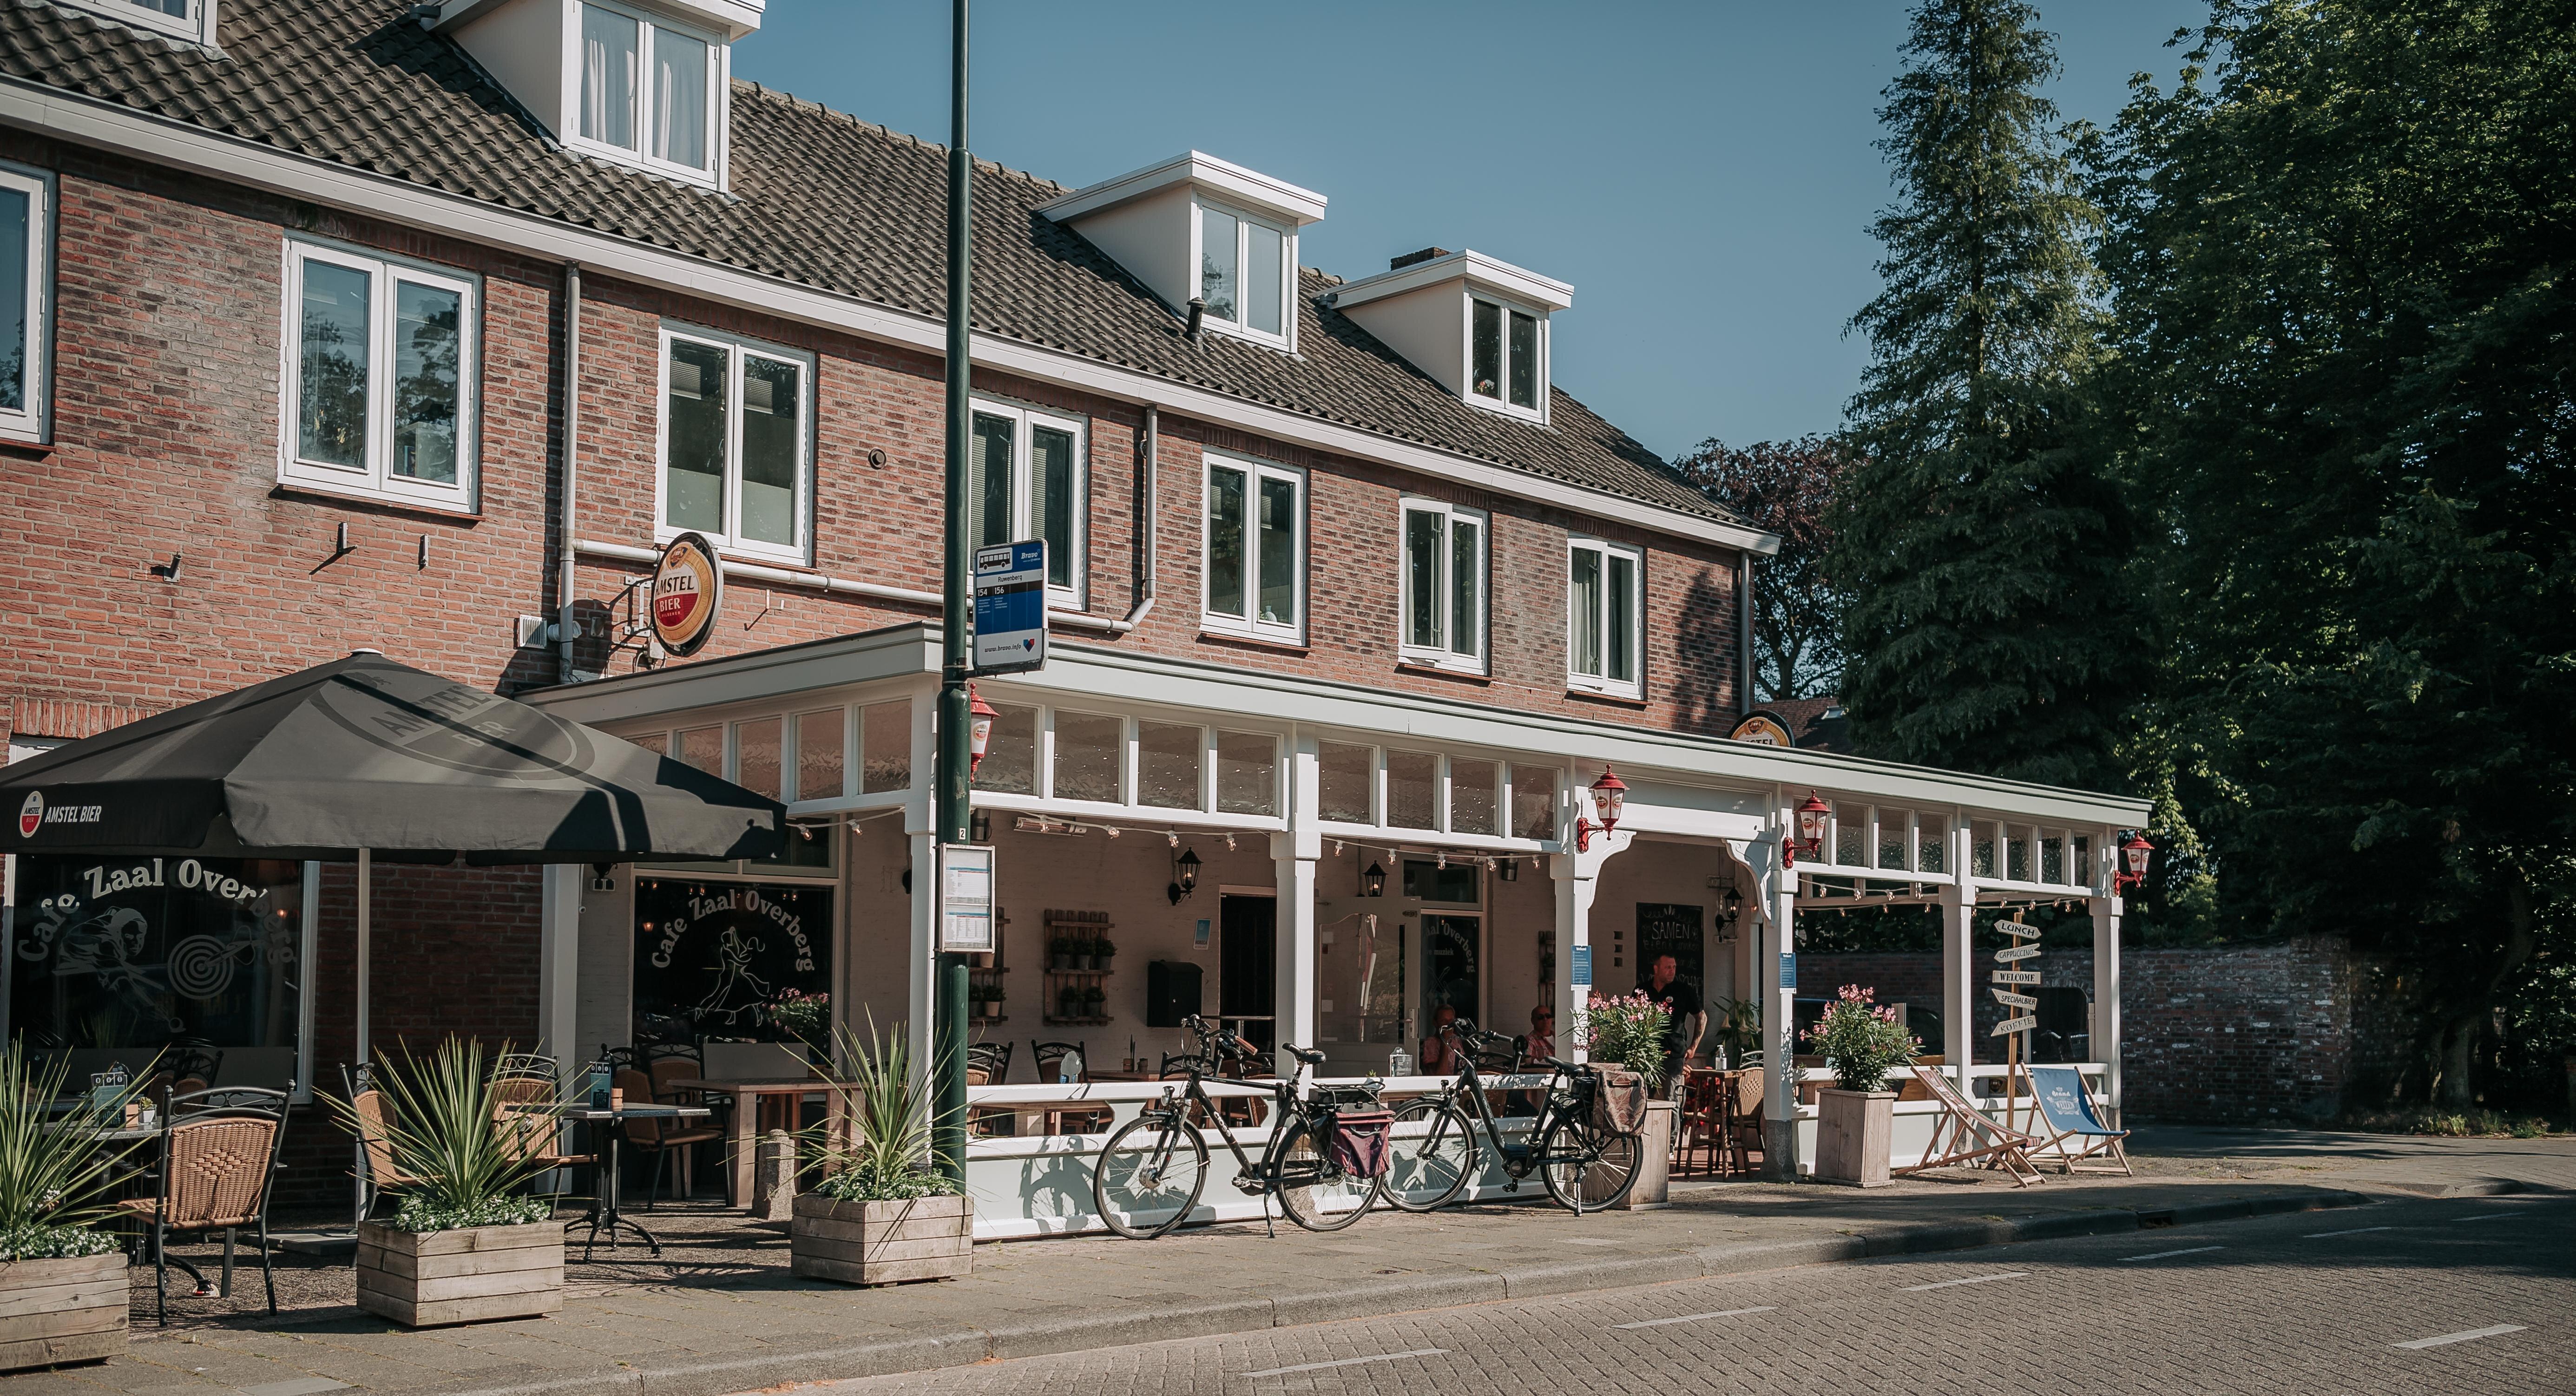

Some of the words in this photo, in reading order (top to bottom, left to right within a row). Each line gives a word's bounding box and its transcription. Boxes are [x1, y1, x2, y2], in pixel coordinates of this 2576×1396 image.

[656, 576, 695, 596] AMSTEL
[659, 597, 681, 612] BIER
[984, 643, 1021, 653] www.bravo.info
[24, 806, 41, 815] AMSTEL
[45, 806, 78, 823] AMSTEL
[79, 805, 102, 822] BIER
[17, 894, 80, 962] Cafe
[84, 859, 164, 899] Zaal
[652, 918, 687, 968] Cafe
[689, 889, 737, 921] Zaal
[745, 891, 815, 971] Overberg
[1652, 921, 1690, 939] SAMEN
[2001, 923, 2035, 937] LUNCH
[1443, 923, 1476, 973] Overberg
[1999, 949, 2034, 958] CAPPUCCINO
[1999, 973, 2035, 982] WELCOME
[2001, 995, 2036, 1005] SPECIAALBIER
[2000, 1017, 2033, 1034] KOFFIE
